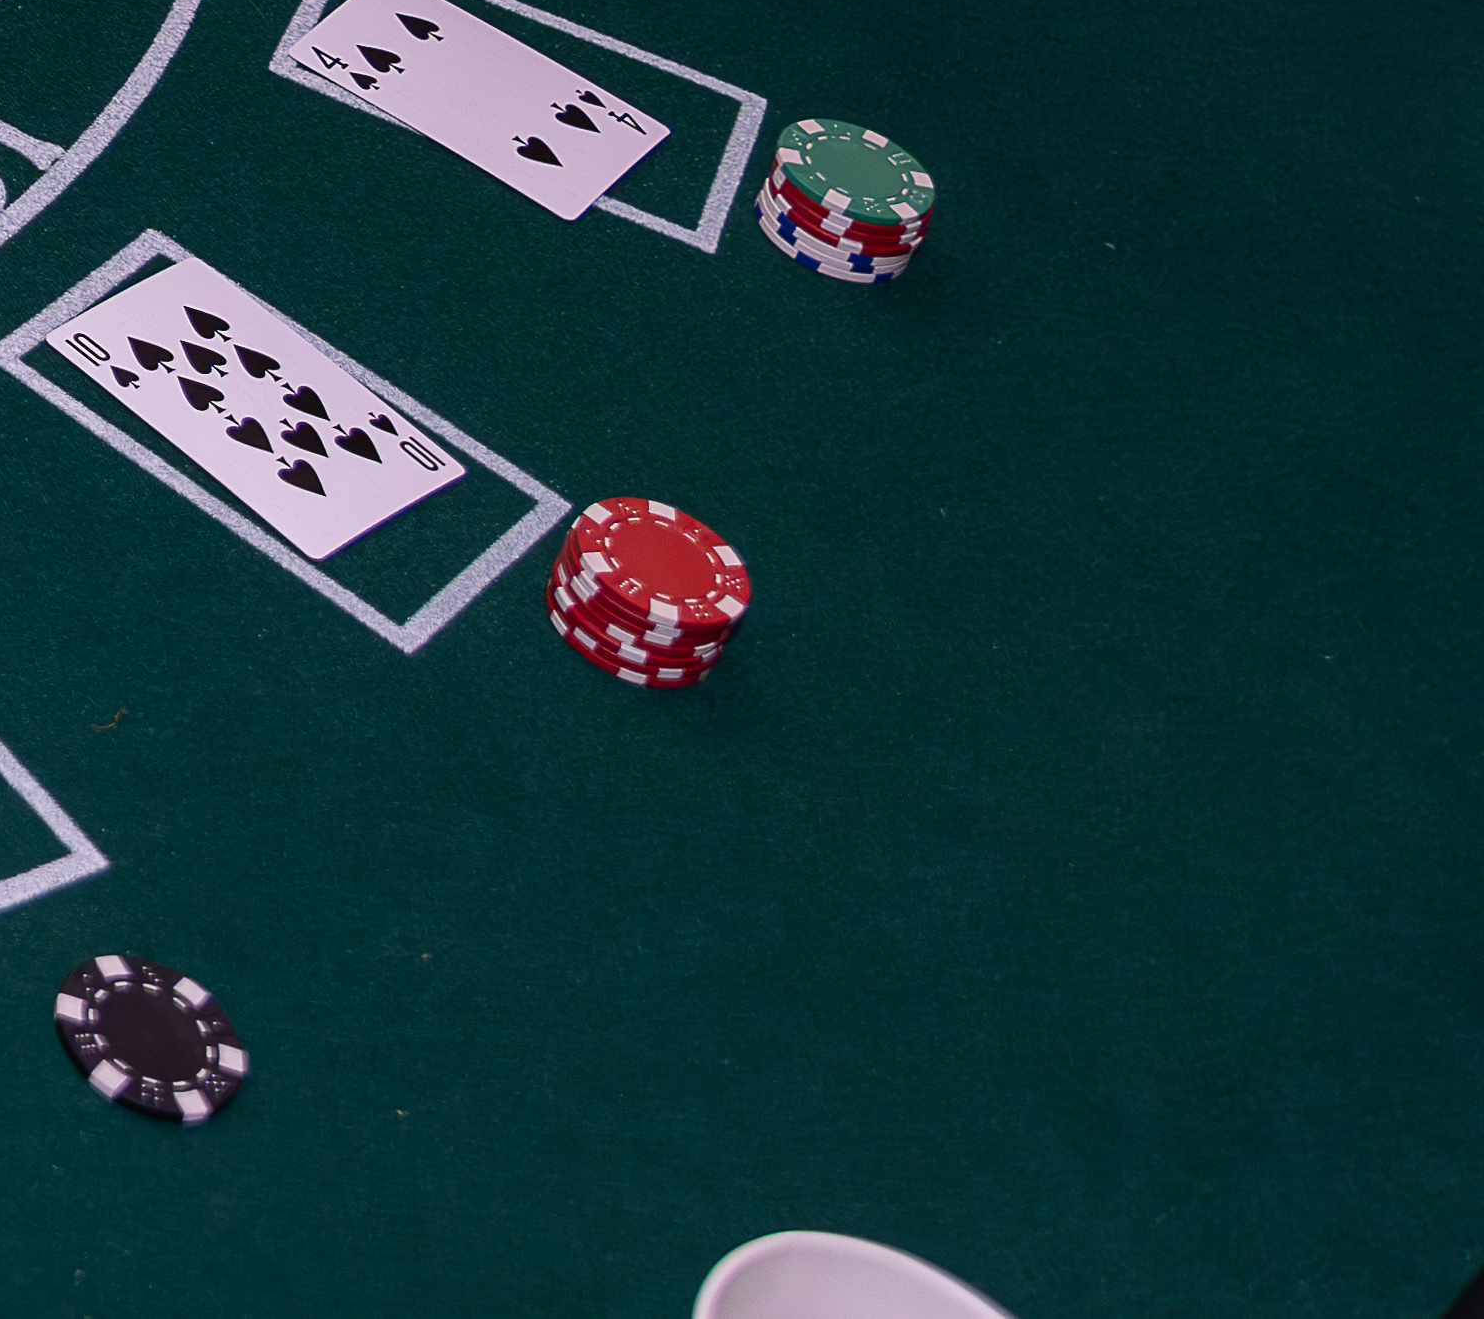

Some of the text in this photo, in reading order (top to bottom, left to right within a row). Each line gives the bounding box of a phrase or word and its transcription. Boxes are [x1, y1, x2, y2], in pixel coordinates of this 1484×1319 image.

[312, 46, 349, 69] 4
[608, 111, 646, 135] 4
[65, 332, 111, 366] 10
[399, 436, 446, 471] 10
